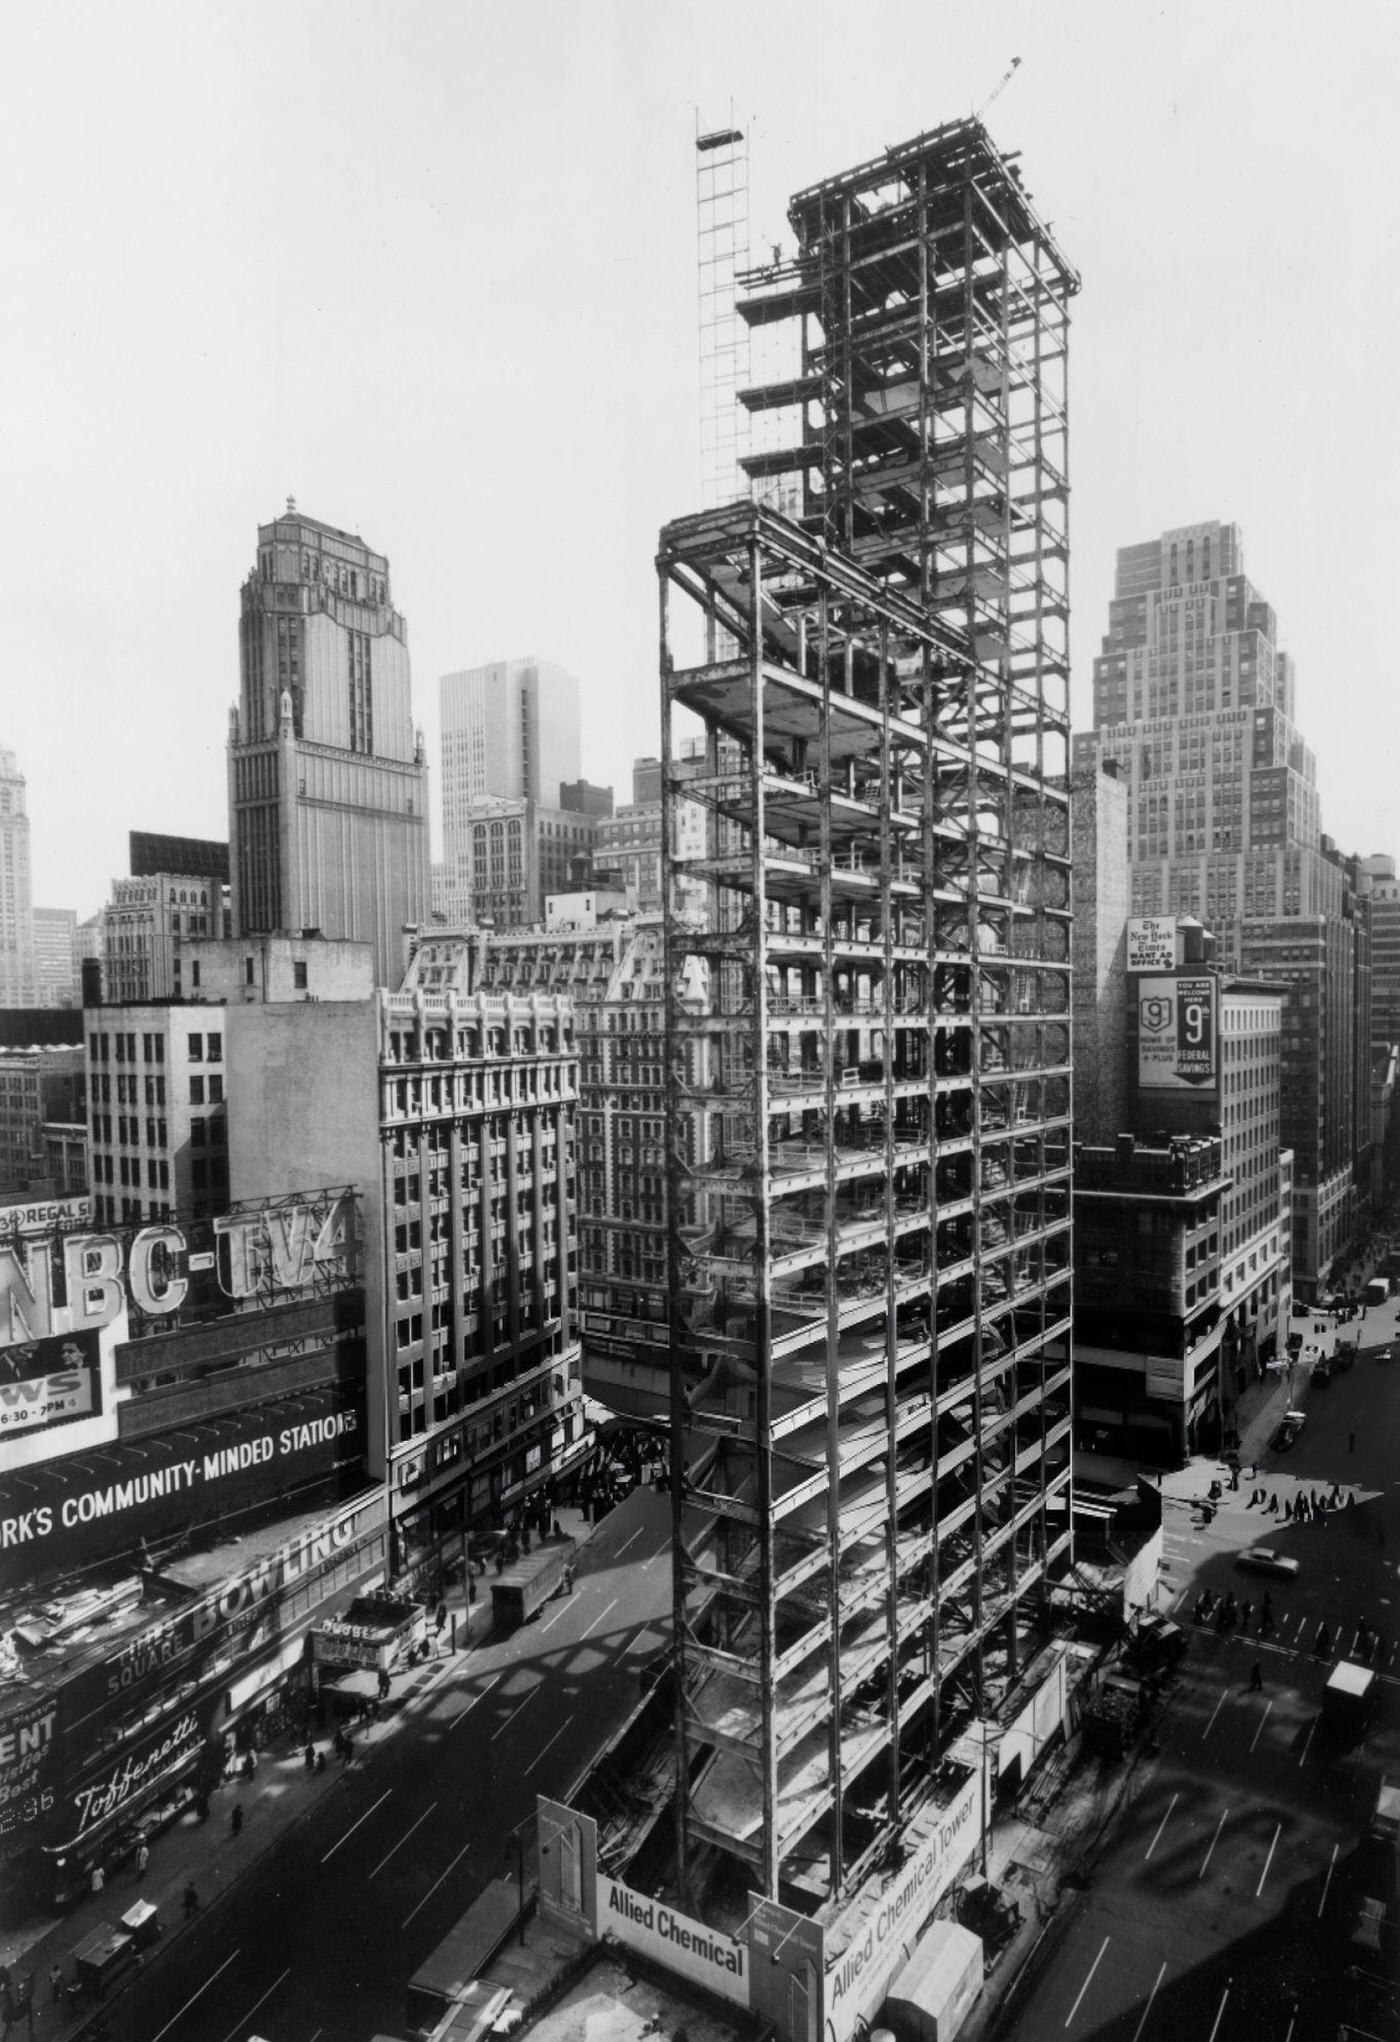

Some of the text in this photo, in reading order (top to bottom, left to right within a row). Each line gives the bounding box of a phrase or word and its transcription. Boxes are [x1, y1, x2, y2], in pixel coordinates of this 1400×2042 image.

[1142, 920, 1160, 931] The
[1131, 931, 1173, 943] New York
[1137, 942, 1166, 953] Times
[1140, 1036, 1177, 1044] HOME OF
[1141, 1045, 1176, 1053] SAVINGS
[1178, 1050, 1210, 1061] FEDERAL
[1178, 1062, 1210, 1074] SAVINGS
[27, 1204, 75, 1223] REGAL
[1, 1409, 28, 1424] 6:30
[62, 1436, 274, 1528] COMMUNITY-MINDED
[107, 1632, 184, 1697] SQUARE
[75, 1711, 198, 1832] Toffenetti
[833, 1929, 873, 2011] Allied
[877, 1838, 937, 1943] Chemical
[938, 1792, 975, 1856] Tower
[609, 1885, 654, 1931] Allied
[658, 1910, 743, 1977] Chemical
